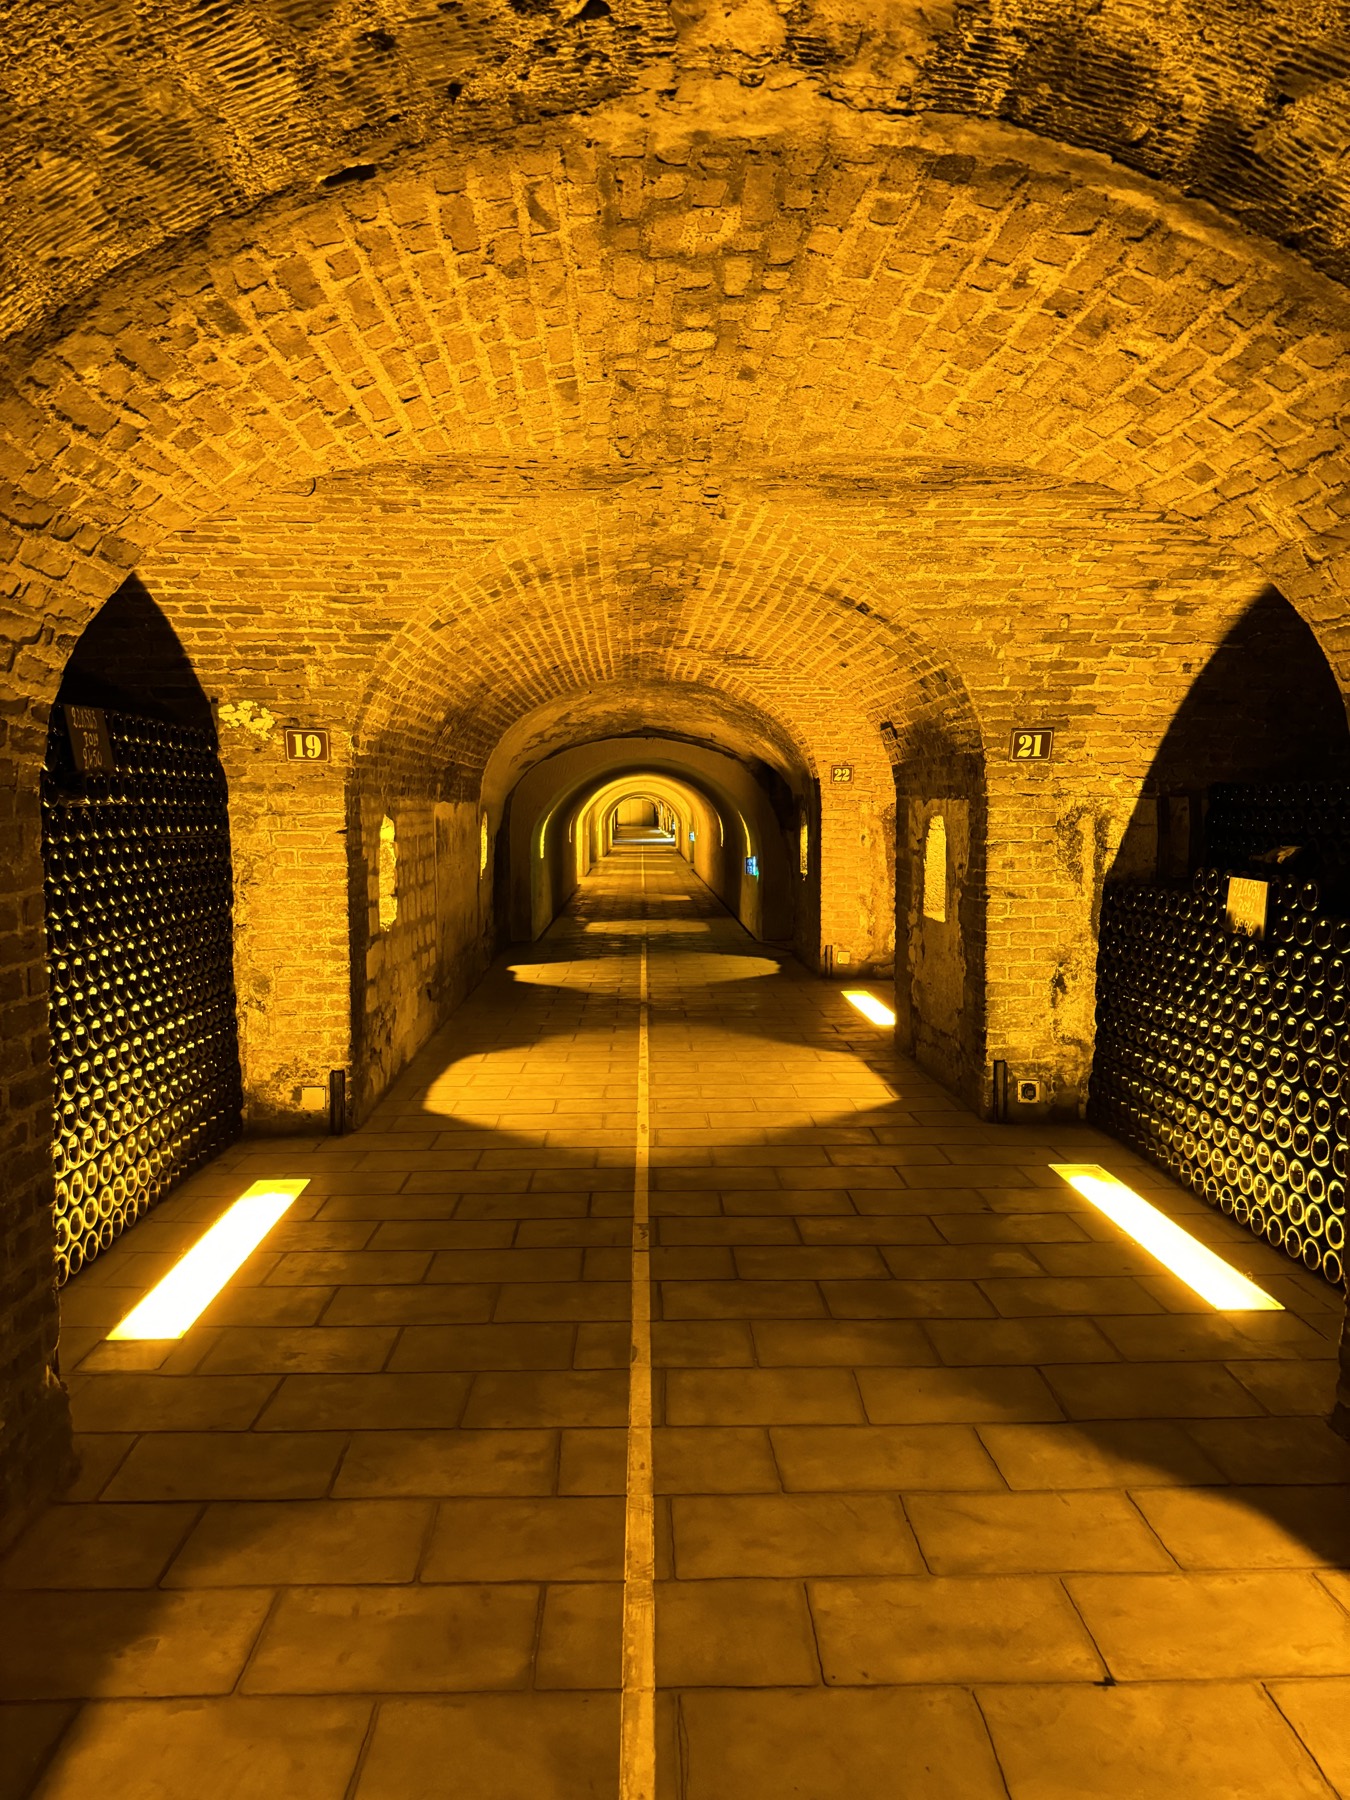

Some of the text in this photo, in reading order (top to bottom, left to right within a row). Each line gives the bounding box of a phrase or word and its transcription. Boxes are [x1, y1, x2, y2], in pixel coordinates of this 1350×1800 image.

[292, 734, 322, 759] 19
[1017, 734, 1043, 758] 21
[833, 768, 850, 782] 22
